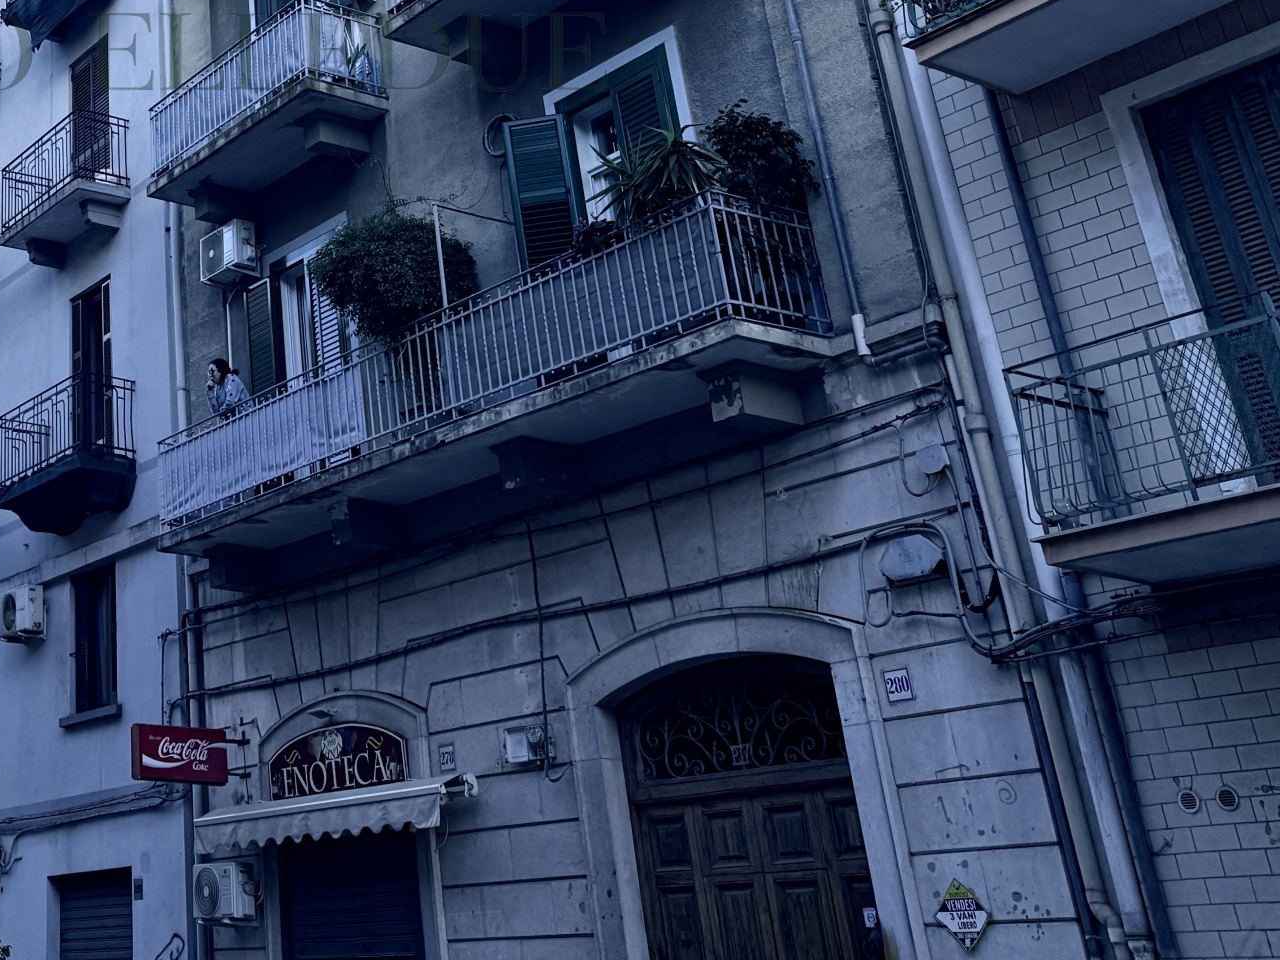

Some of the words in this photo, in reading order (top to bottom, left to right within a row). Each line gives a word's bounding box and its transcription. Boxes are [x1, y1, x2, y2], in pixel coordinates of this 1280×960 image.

[886, 675, 910, 694] 280
[158, 736, 209, 761] Coca-Cola
[192, 761, 209, 771] Coke
[281, 749, 389, 798] ENOTECA
[945, 899, 977, 911] VENDESI
[949, 912, 956, 921] 3
[956, 911, 977, 921] VANI
[957, 921, 978, 930] LIBERO
